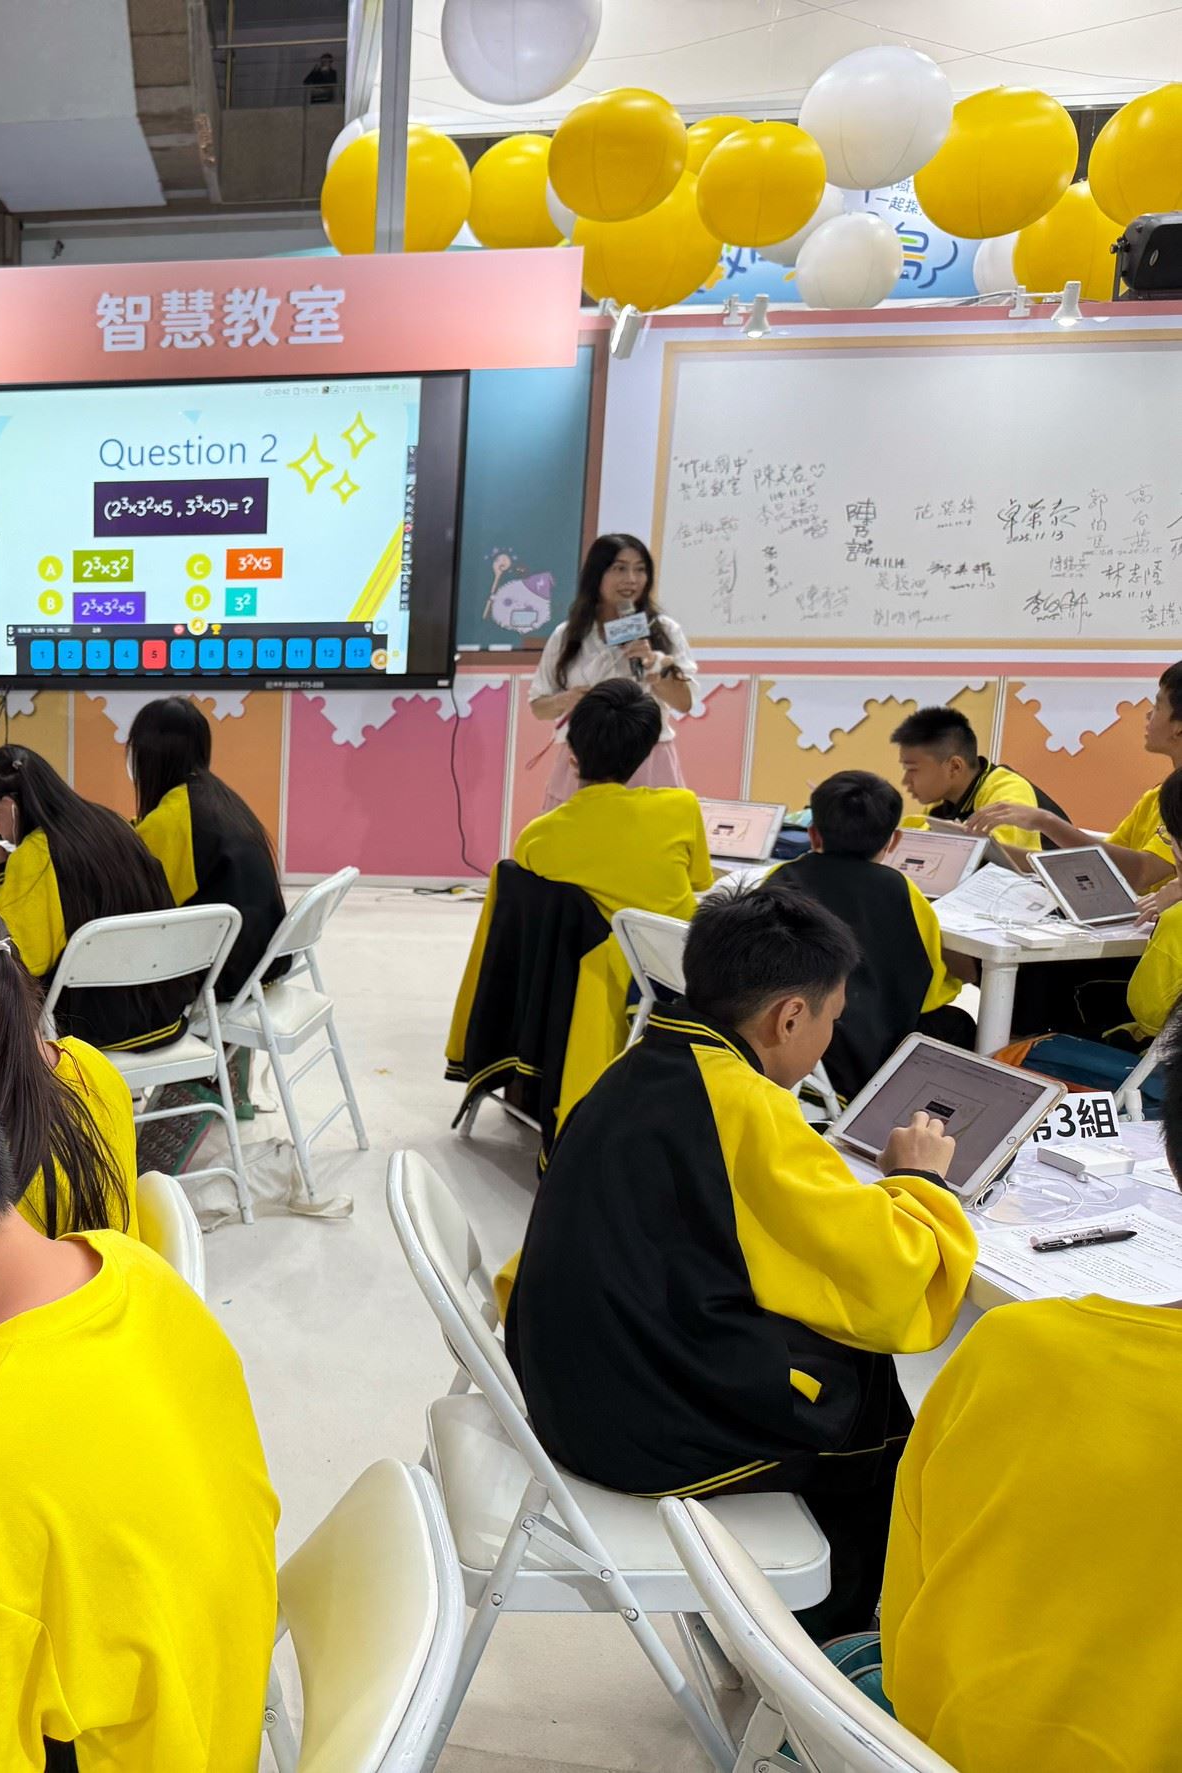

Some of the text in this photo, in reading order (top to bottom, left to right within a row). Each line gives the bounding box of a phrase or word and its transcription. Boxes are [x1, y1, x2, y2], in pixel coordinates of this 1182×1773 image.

[96, 284, 345, 352] 智慧教室
[99, 434, 278, 470] Question 2
[242, 496, 254, 515] ?
[46, 563, 57, 577] A
[193, 562, 204, 575] C
[46, 597, 56, 611] B
[192, 594, 205, 607] D
[40, 651, 45, 659] 1
[67, 650, 74, 659] 2
[95, 650, 101, 659] 3
[123, 650, 129, 659] 4
[151, 650, 157, 659] 5
[180, 650, 185, 658] 7
[237, 650, 243, 658] 9
[265, 650, 275, 658] 10
[324, 649, 334, 657] 12
[353, 649, 364, 657] 13
